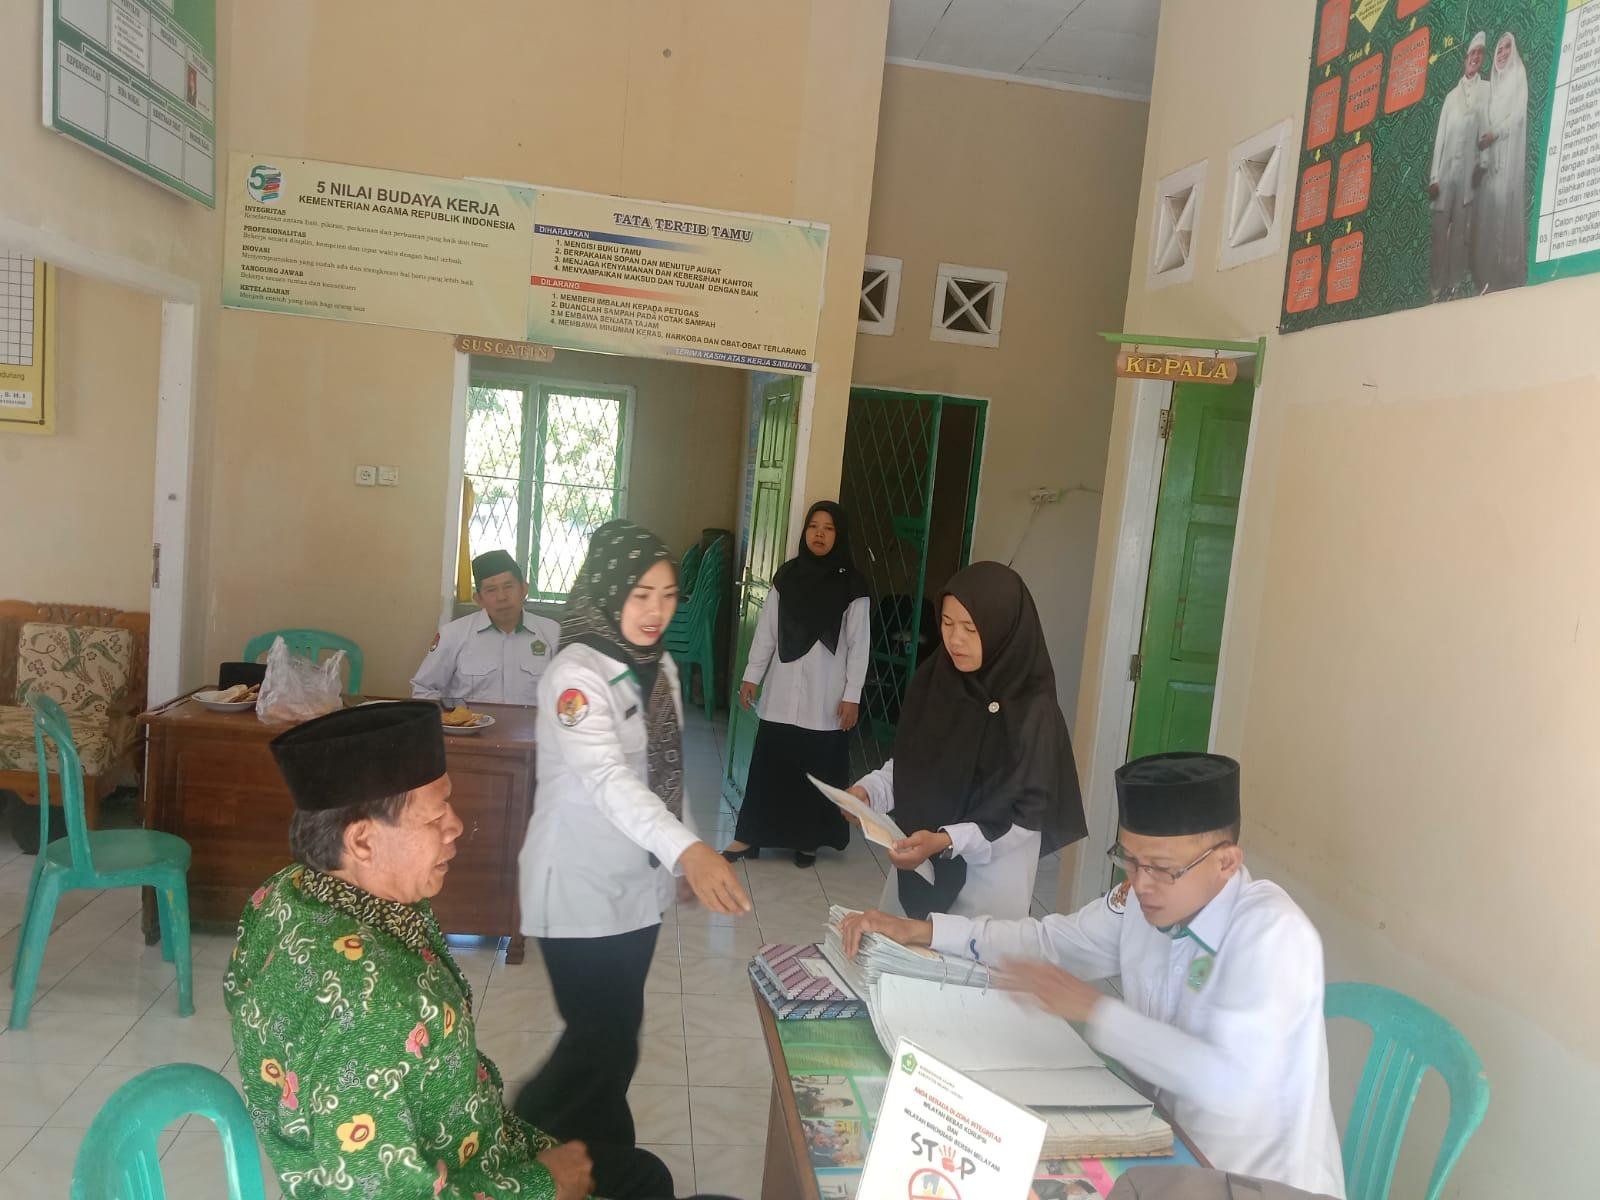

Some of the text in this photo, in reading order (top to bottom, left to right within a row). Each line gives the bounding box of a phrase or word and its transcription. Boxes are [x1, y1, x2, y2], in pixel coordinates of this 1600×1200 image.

[1560, 160, 1586, 174] dengan
[316, 180, 500, 217] 5 NILAI BUDAYA KERJA
[1570, 190, 1582, 204] dan
[244, 205, 286, 216] INTEGRITAS
[298, 195, 516, 231] KEMENTERIAN AGAMA REPUBLIK INDONESIA
[612, 212, 752, 242] TATA TERTIB TAMU
[1554, 216, 1574, 228] Calon
[243, 225, 306, 238] PROFESIONALITAS
[380, 228, 392, 236] dan
[540, 226, 590, 239] DIHARAPKAN
[242, 244, 270, 254] INOVASI
[348, 244, 360, 252] dan
[400, 250, 422, 260] dengan
[564, 240, 596, 251] MENGISI
[598, 244, 619, 254] BUKU
[620, 247, 642, 256] TAMU
[349, 264, 362, 272] dan
[555, 247, 722, 276] 2. BERPAKAIAN SOPAN DAN MENUTUP AURAT
[280, 268, 304, 277] JAWAB
[554, 255, 753, 288] 3. MENJAGA KENYAMANAN DAN KEBERSIHAN KANTOR
[540, 278, 580, 290] DILARANG
[554, 264, 759, 298] 4. MENYAMPAIKAN MAKSUD DAN TUJUAN DENGAN BAIK
[240, 284, 290, 296] KETELADANAN
[560, 294, 596, 305] MEMBERI
[597, 298, 630, 310] IMBALAN
[632, 304, 663, 314] KEPADA
[664, 306, 700, 318] PETUGAS
[560, 302, 602, 314] BUANGLAH
[604, 308, 635, 318] SAMPAH
[636, 311, 657, 321] PADA
[658, 314, 684, 324] KOTAK
[685, 317, 716, 329] SAMPAH
[600, 315, 633, 326] SENJATA
[634, 320, 660, 330] TAJAM
[550, 318, 556, 326] 4.
[558, 318, 598, 331] MEMBAWA
[599, 324, 636, 335] MINUMAN
[665, 332, 702, 344] NARKOBA
[704, 338, 719, 346] DAN
[720, 340, 762, 351] OBAT-OBAT
[764, 344, 807, 356] TERLARANG
[461, 338, 549, 358] SUSCATIN
[674, 348, 808, 371] TERIMA KASIH ATAS KERJA SAMANYA
[1125, 356, 1229, 380] KEPALA
[913, 1086, 929, 1100] ANDA
[970, 1120, 1002, 1144] INTEGRITAS
[923, 1101, 946, 1119] WILAYAH
[946, 1125, 959, 1137] DAN
